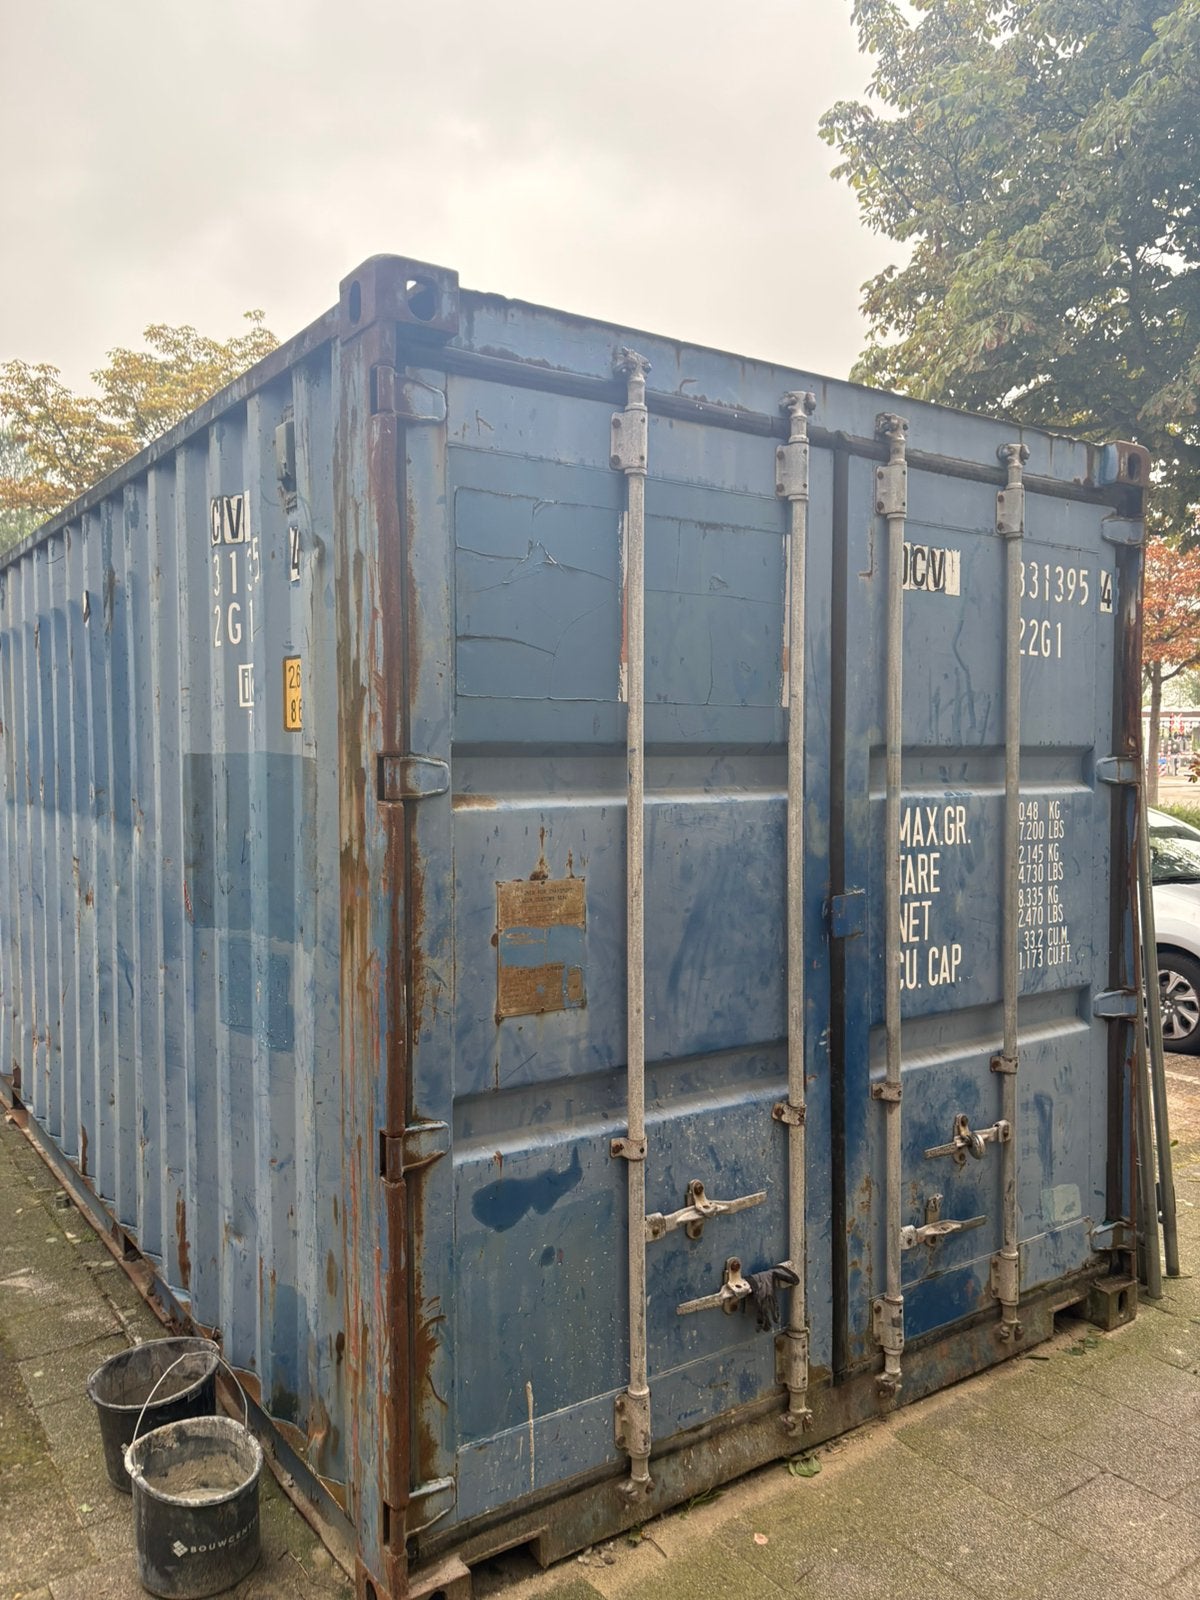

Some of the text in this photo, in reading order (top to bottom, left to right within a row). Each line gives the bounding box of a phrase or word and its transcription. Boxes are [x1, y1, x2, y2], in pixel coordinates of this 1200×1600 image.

[1101, 572, 1113, 611] 4
[1048, 800, 1061, 820] KG
[1048, 819, 1065, 839] LBS
[900, 852, 940, 896] TARE
[1048, 843, 1060, 862] KG
[1048, 862, 1064, 881] LBS
[900, 900, 932, 943] NET
[1047, 885, 1059, 905] KG
[1047, 904, 1064, 924] LBS
